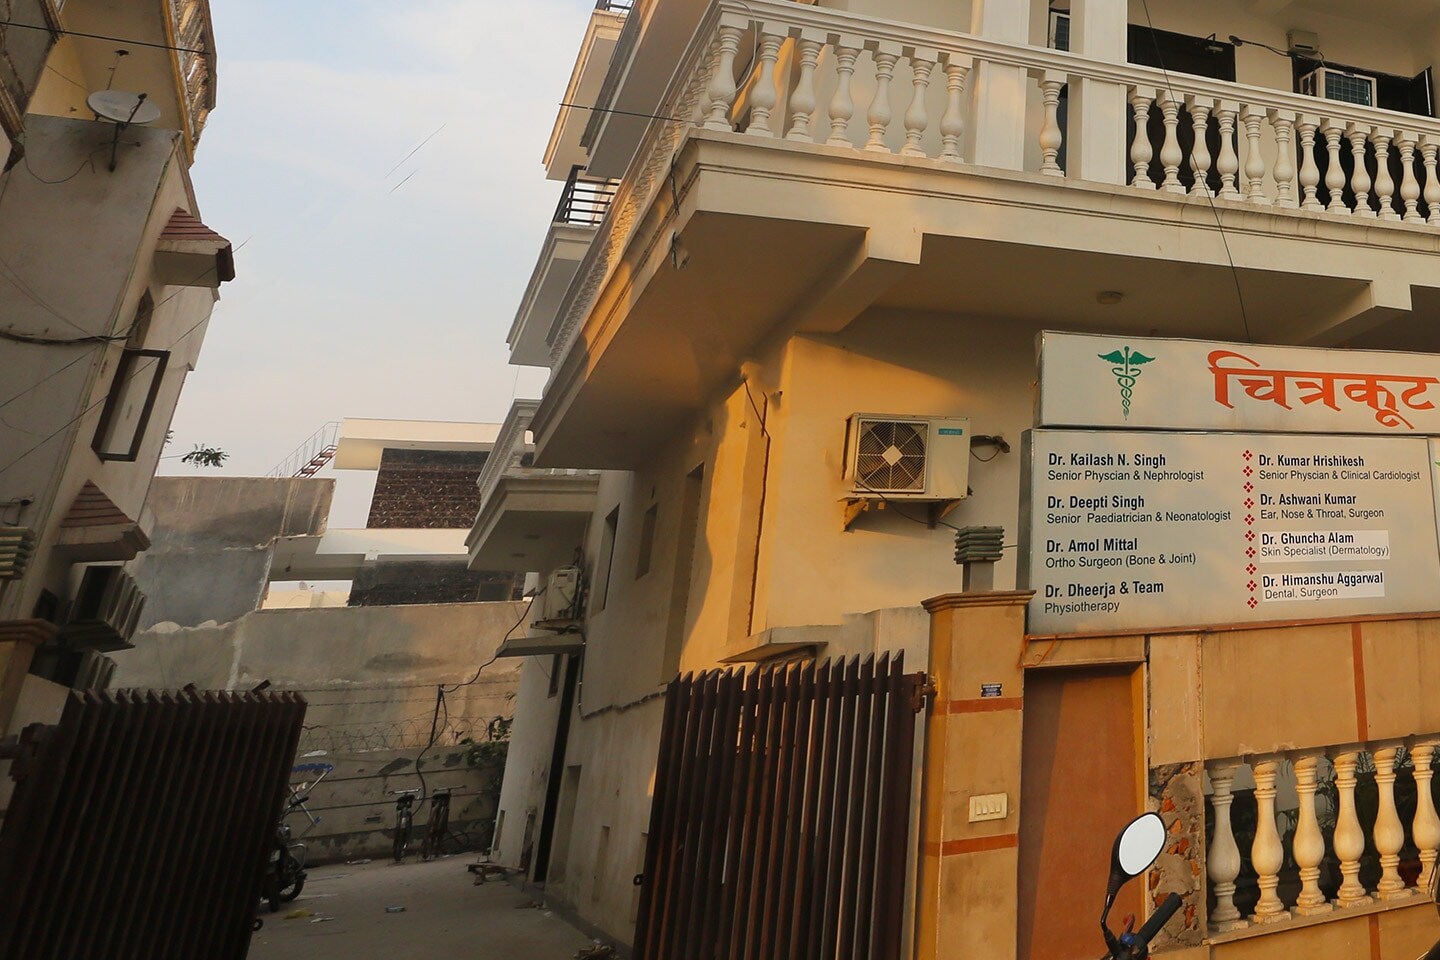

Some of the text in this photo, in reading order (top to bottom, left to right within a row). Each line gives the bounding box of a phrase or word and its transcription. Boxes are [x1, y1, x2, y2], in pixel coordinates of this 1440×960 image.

[1207, 350, 1440, 429] चित्रकूट
[1049, 453, 1166, 468] Dr. Kailash N. Singh
[1259, 455, 1364, 467] Dr. Kumar Hrishikesh
[1048, 470, 1204, 482] Senior Physcian & Nephrologist
[1259, 470, 1420, 482] Senior Physcian & Clinical Cardiologist
[1048, 496, 1144, 511] Dr. Deepti Singh
[1261, 494, 1356, 505] Dr. Ashwani Kumar
[1047, 511, 1231, 524] Senior Paediatrician & Neonatologist
[1261, 509, 1384, 520] Ear, Nose & Throat, Surgeon
[1262, 532, 1354, 545] Dr. Ghuncha Alam
[1046, 538, 1137, 553] Dr. Amol Mittal
[1261, 545, 1389, 557] Skin Specialist (Dermatology)
[1046, 553, 1196, 569] Ortho Surgeon (Bone & Joint)
[1263, 572, 1383, 587] Dr. Himanshu Aggarwal
[1045, 581, 1163, 598] Dr. Dheerja & Team
[1265, 588, 1337, 600] Dental, Surgeon
[1045, 601, 1120, 615] Physiotherapy
